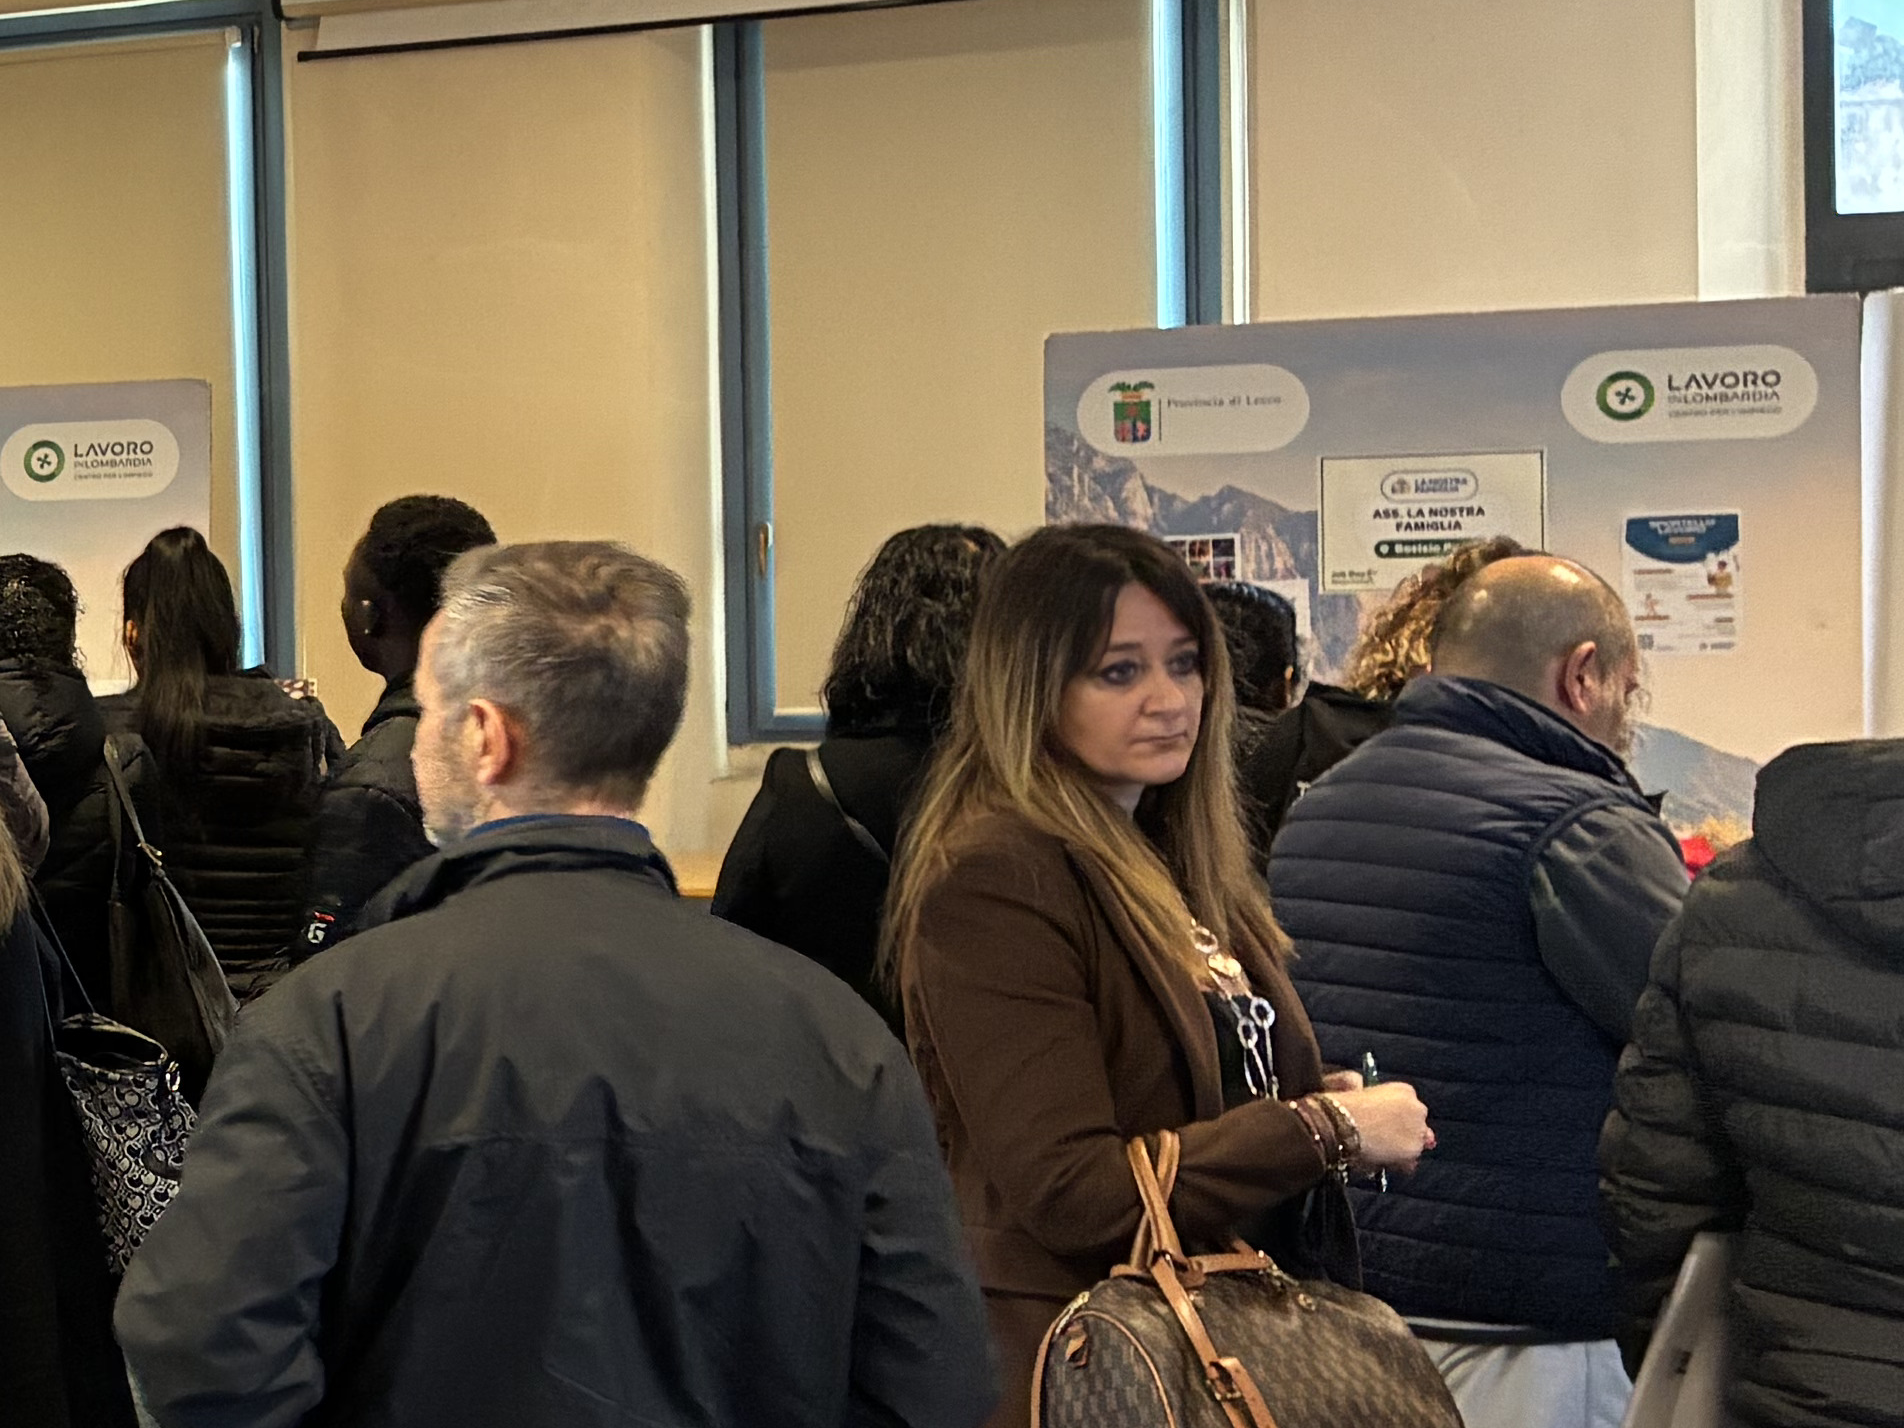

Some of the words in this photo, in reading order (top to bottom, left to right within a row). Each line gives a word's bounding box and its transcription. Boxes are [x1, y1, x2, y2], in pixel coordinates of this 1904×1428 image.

[1668, 370, 1781, 391] LAVORO
[74, 440, 153, 458] LAVORO
[1407, 508, 1426, 519] LA
[1428, 505, 1486, 518] NOSTRA
[1395, 520, 1463, 532] FAMIGLIA
